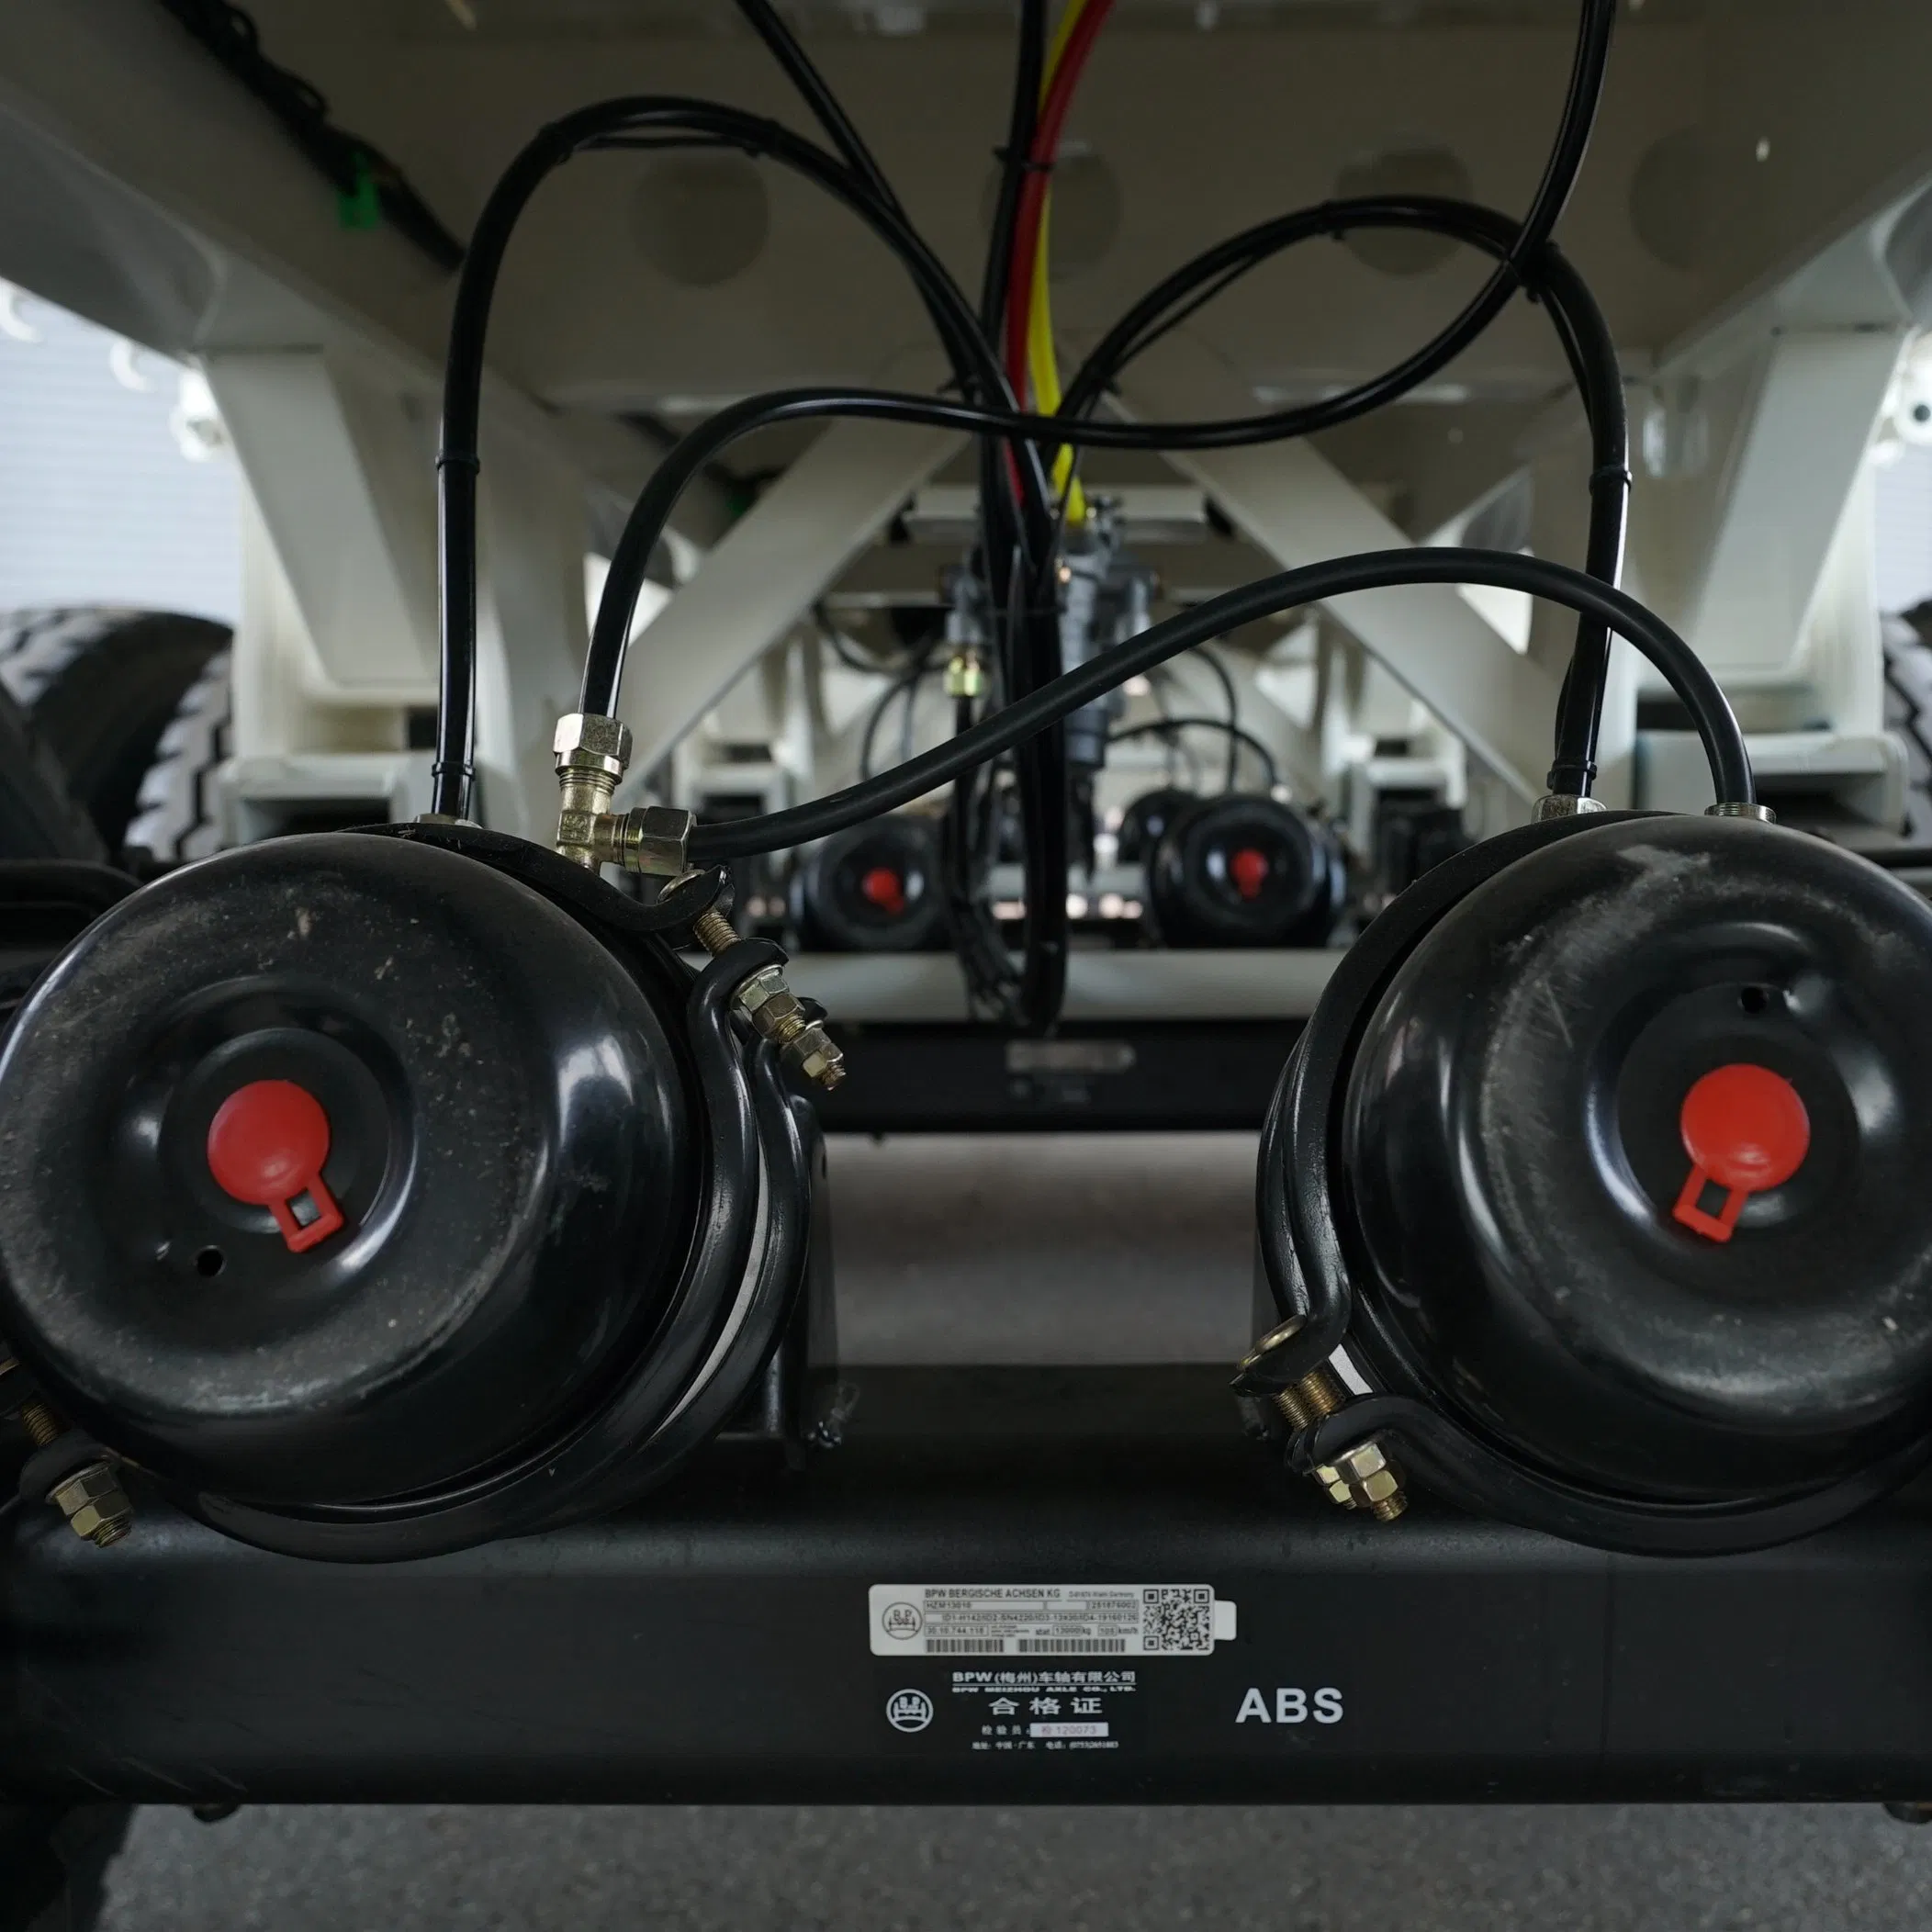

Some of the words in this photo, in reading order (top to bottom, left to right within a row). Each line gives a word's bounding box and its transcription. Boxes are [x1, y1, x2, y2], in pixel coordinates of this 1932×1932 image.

[925, 1589, 946, 1598] BPW
[949, 1589, 1003, 1598] BERGISCHE
[1005, 1589, 1045, 1598] ACHSEN
[1047, 1589, 1061, 1598] KG
[988, 1697, 1103, 1715] 合格证
[1235, 1688, 1343, 1724] ABS
[1056, 1725, 1097, 1735] 120073
